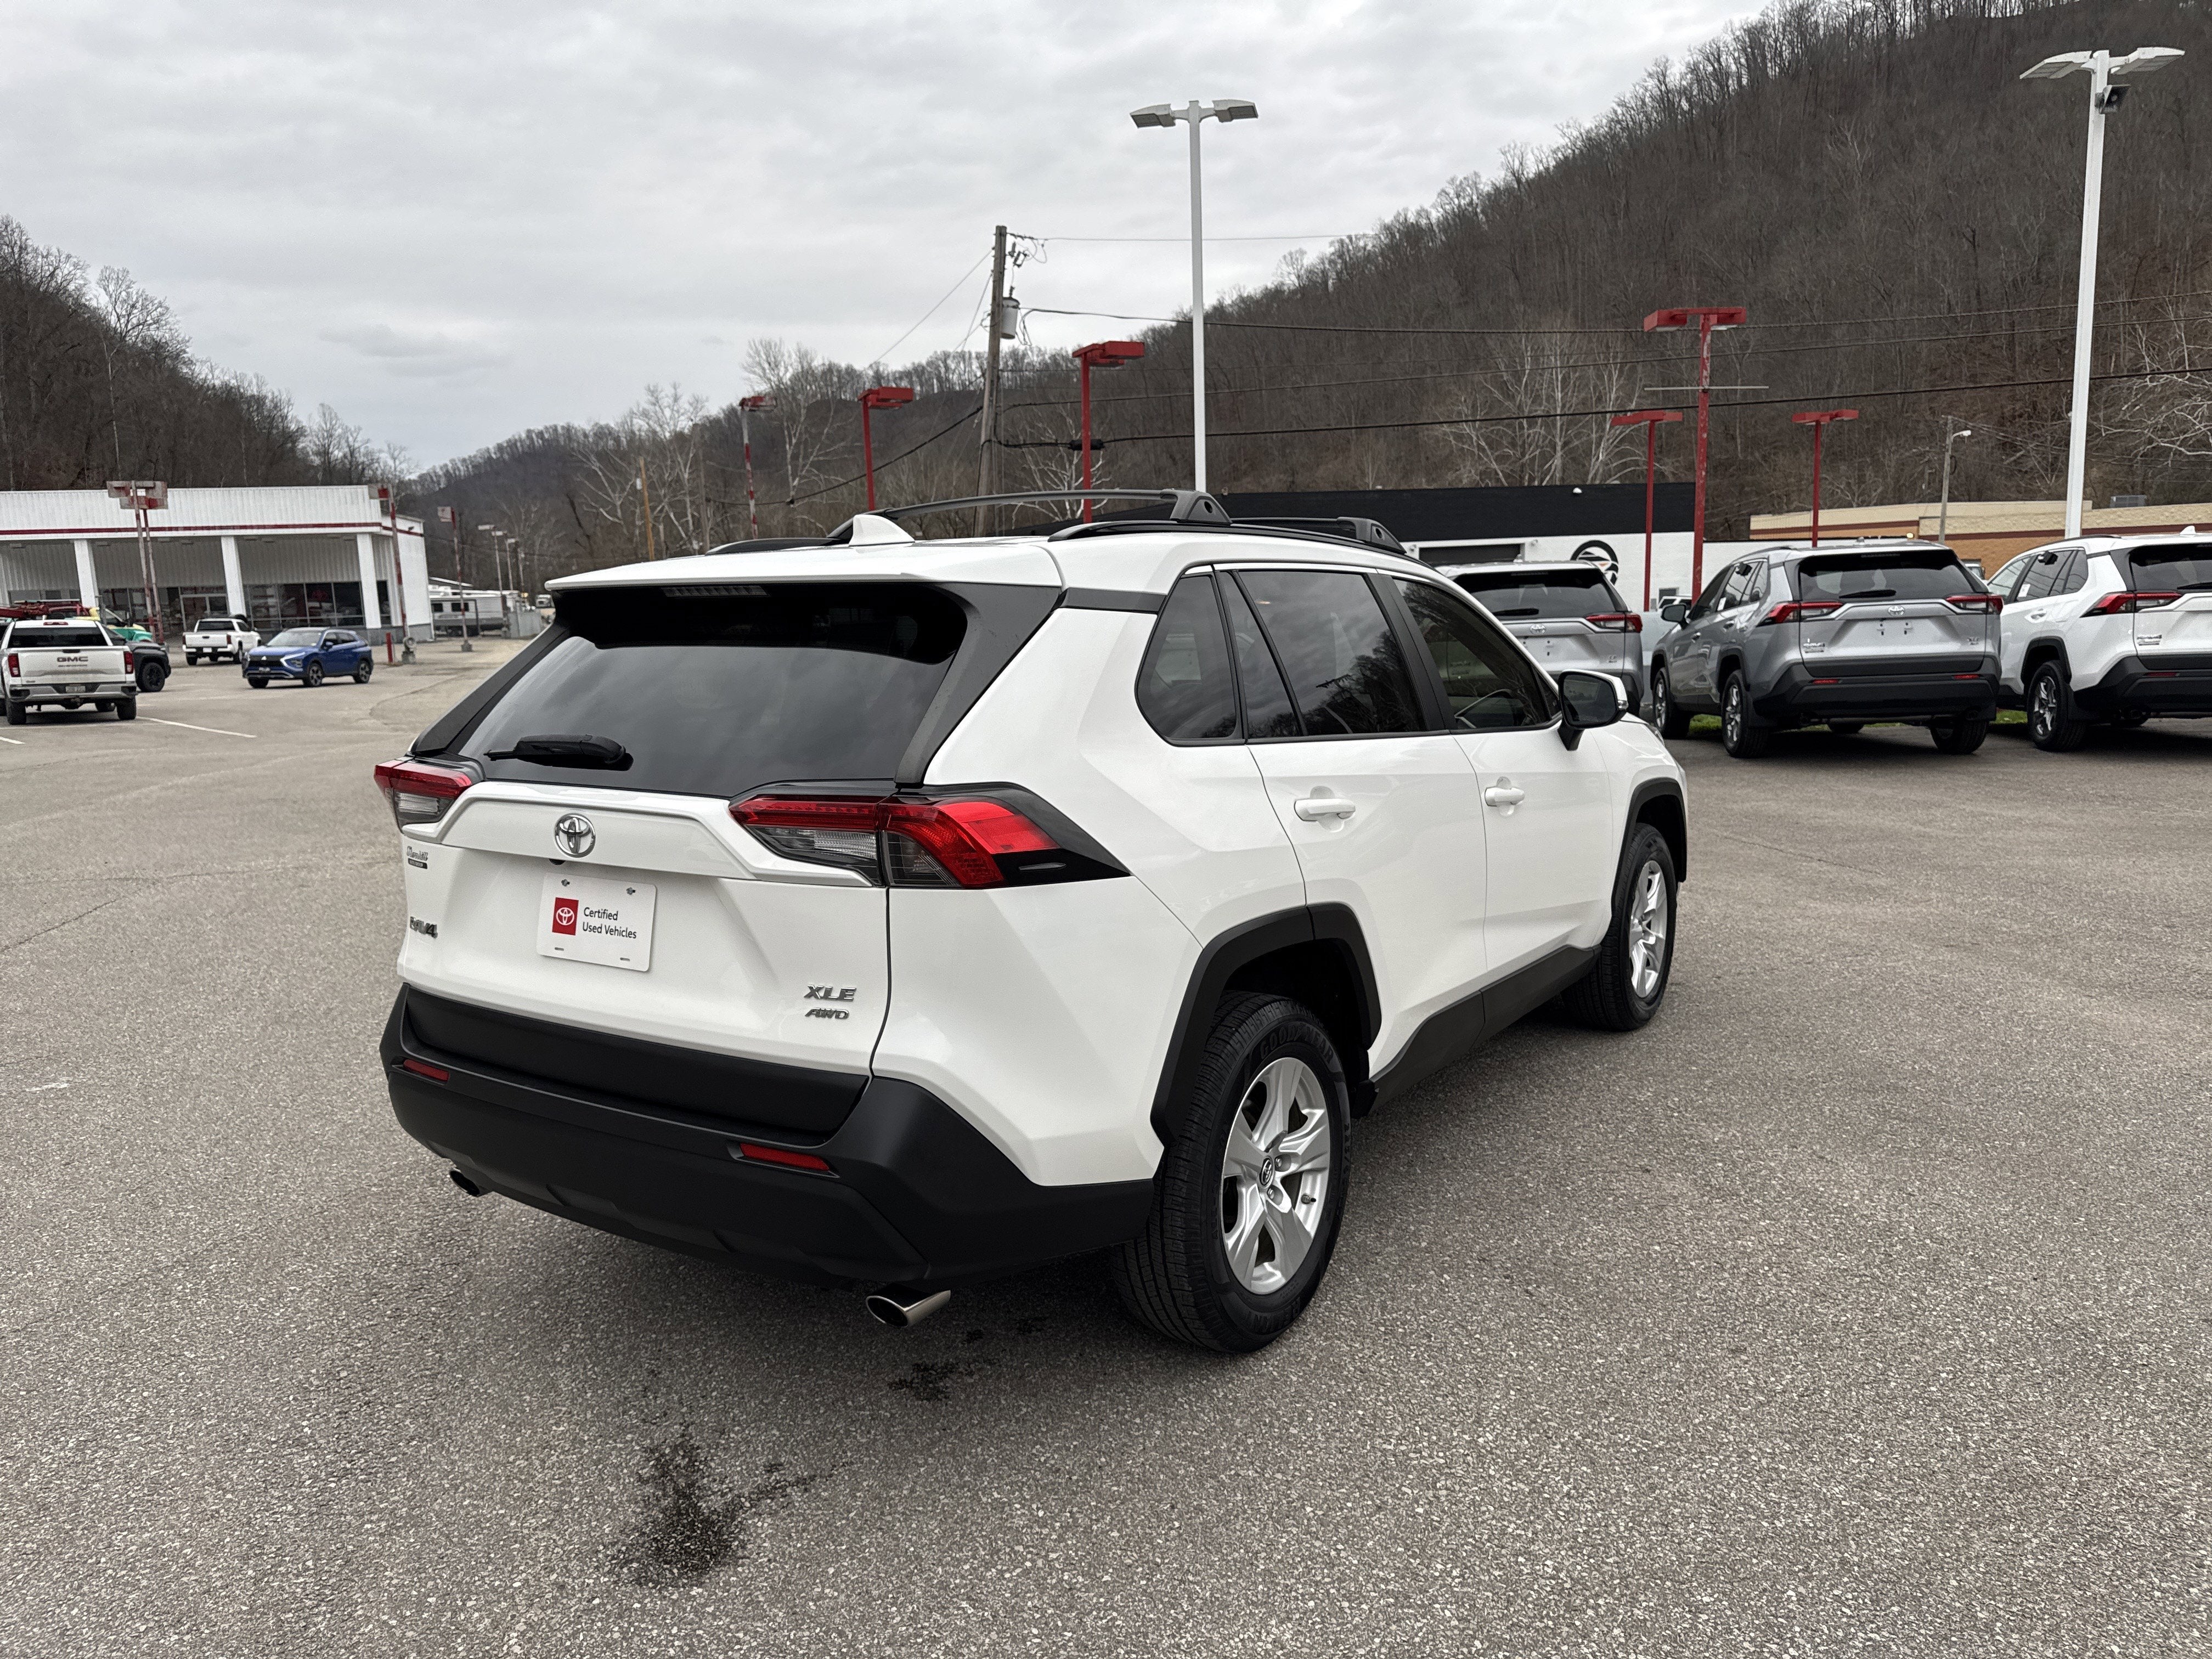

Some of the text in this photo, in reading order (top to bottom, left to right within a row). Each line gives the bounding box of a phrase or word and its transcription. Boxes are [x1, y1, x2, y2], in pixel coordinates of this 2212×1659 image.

[584, 907, 618, 921] Certified
[583, 922, 636, 939] Used Vehicles
[804, 984, 856, 1002] XLE
[805, 1007, 849, 1019] AWD
[1261, 1022, 1334, 1064] GOODYEAR
